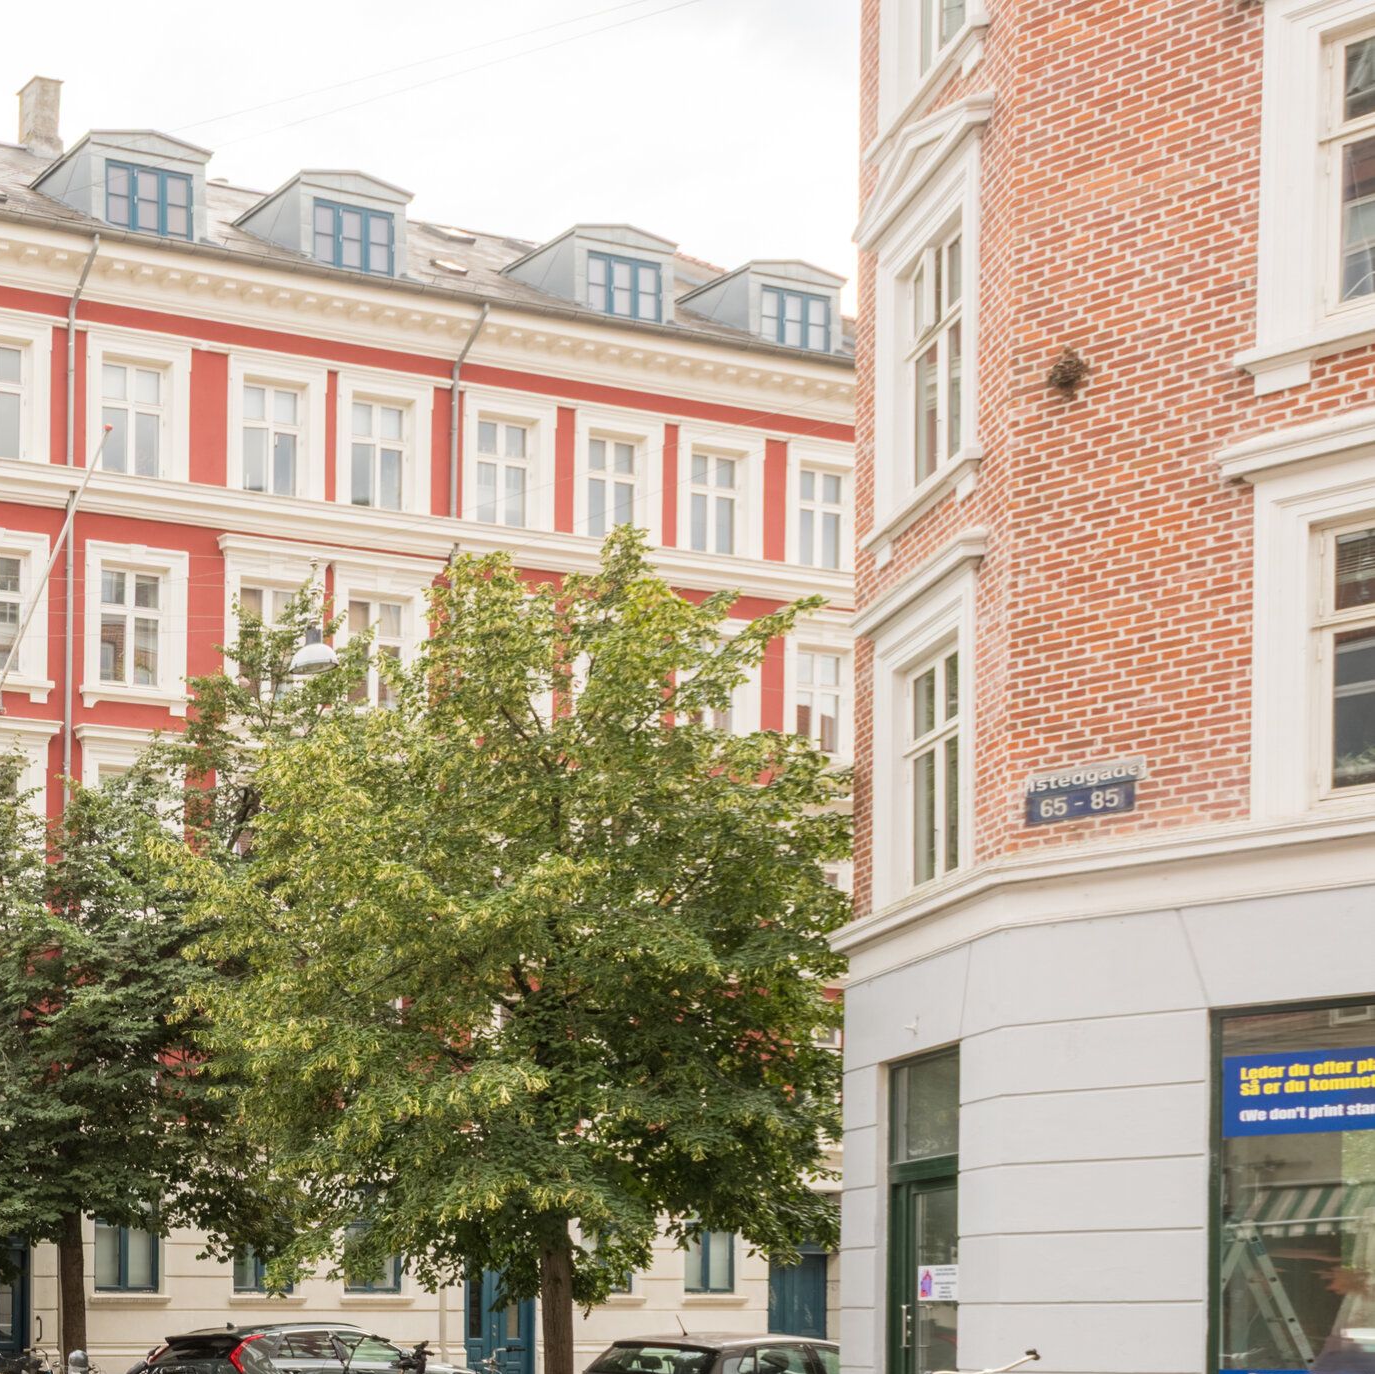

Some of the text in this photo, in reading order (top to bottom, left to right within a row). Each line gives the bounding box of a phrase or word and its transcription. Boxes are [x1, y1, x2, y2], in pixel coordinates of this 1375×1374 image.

[1029, 763, 1140, 793] Istedgade
[1039, 797, 1068, 818] 65
[1090, 788, 1119, 809] 85
[1240, 1065, 1285, 1081] Leder
[1288, 1063, 1311, 1077] du
[1313, 1061, 1354, 1075] efter
[1240, 1079, 1261, 1096] Så
[1263, 1081, 1282, 1095] er
[1284, 1080, 1306, 1093] du
[1239, 1109, 1267, 1122] (We
[1269, 1106, 1307, 1120] don't
[1308, 1104, 1345, 1120] print
